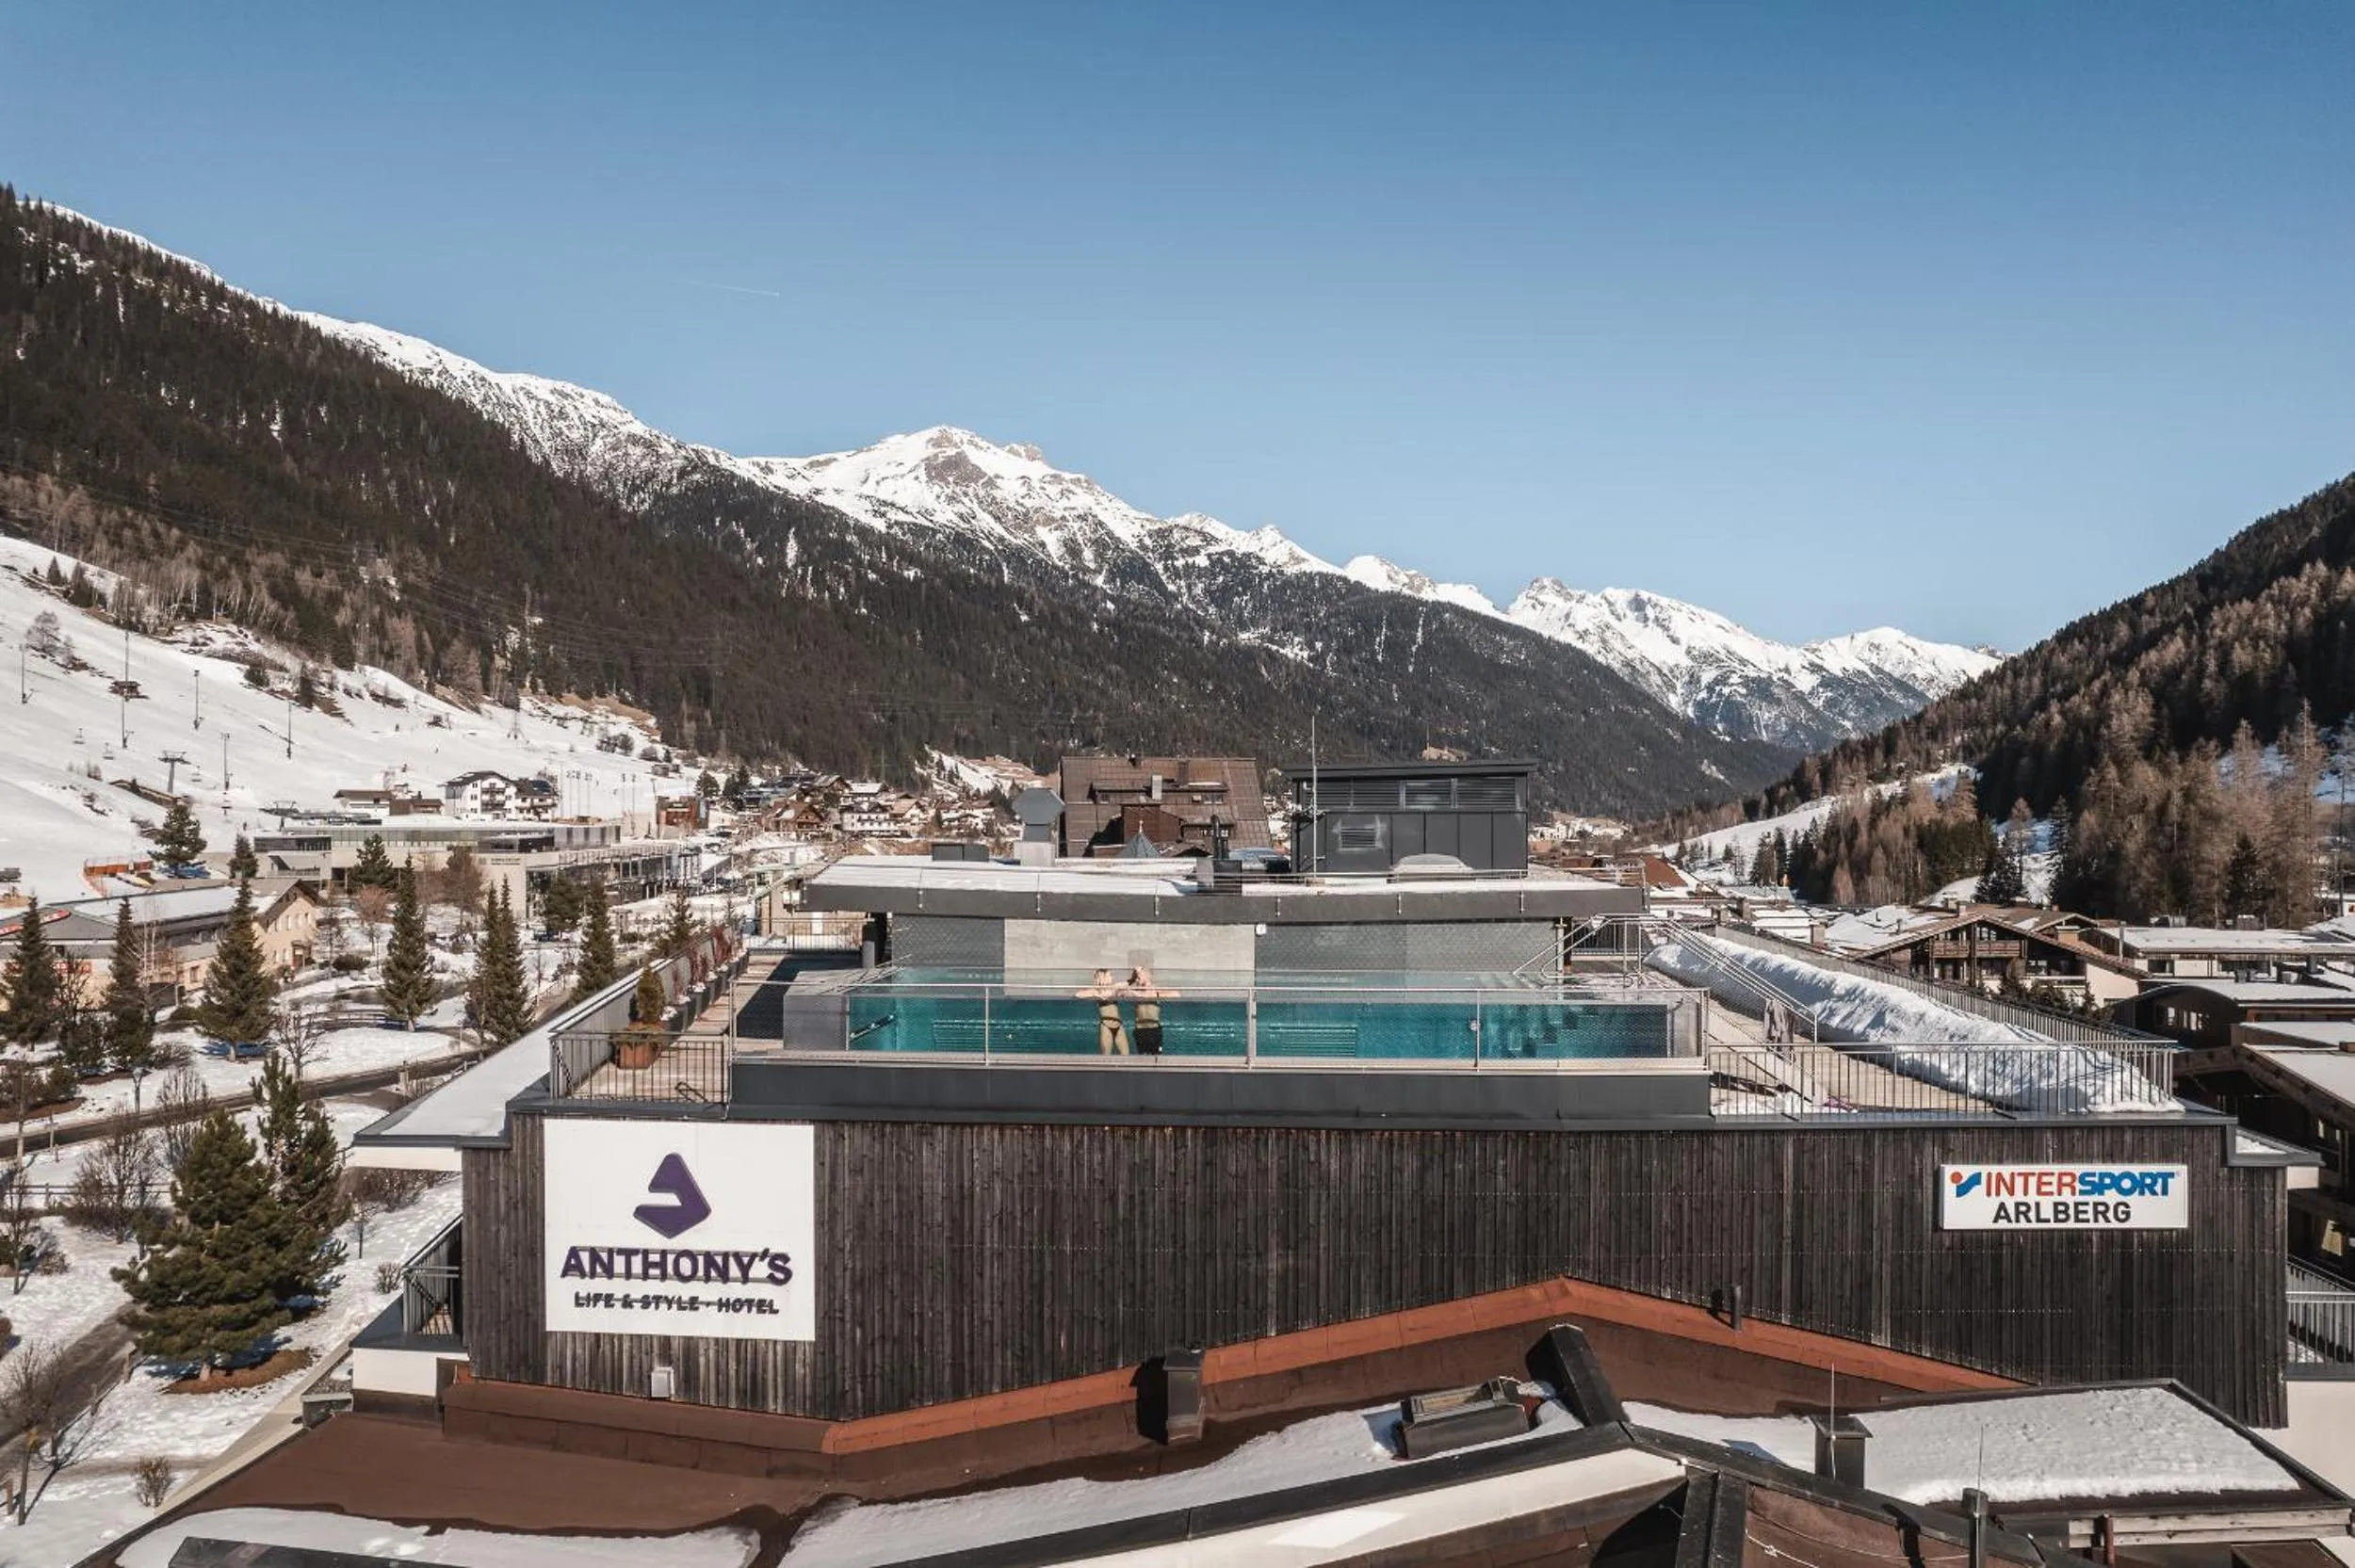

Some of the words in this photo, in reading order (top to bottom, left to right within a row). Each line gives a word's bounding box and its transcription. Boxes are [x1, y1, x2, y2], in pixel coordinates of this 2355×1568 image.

[1985, 1171, 2175, 1198] INTERSPORT
[1991, 1201, 2133, 1224] ARLBERG
[560, 1245, 793, 1286] ANTHONY'S
[574, 1291, 615, 1309] LIFE
[621, 1293, 635, 1310] &
[640, 1294, 700, 1312] STYLE
[717, 1297, 780, 1315] HOTEL
